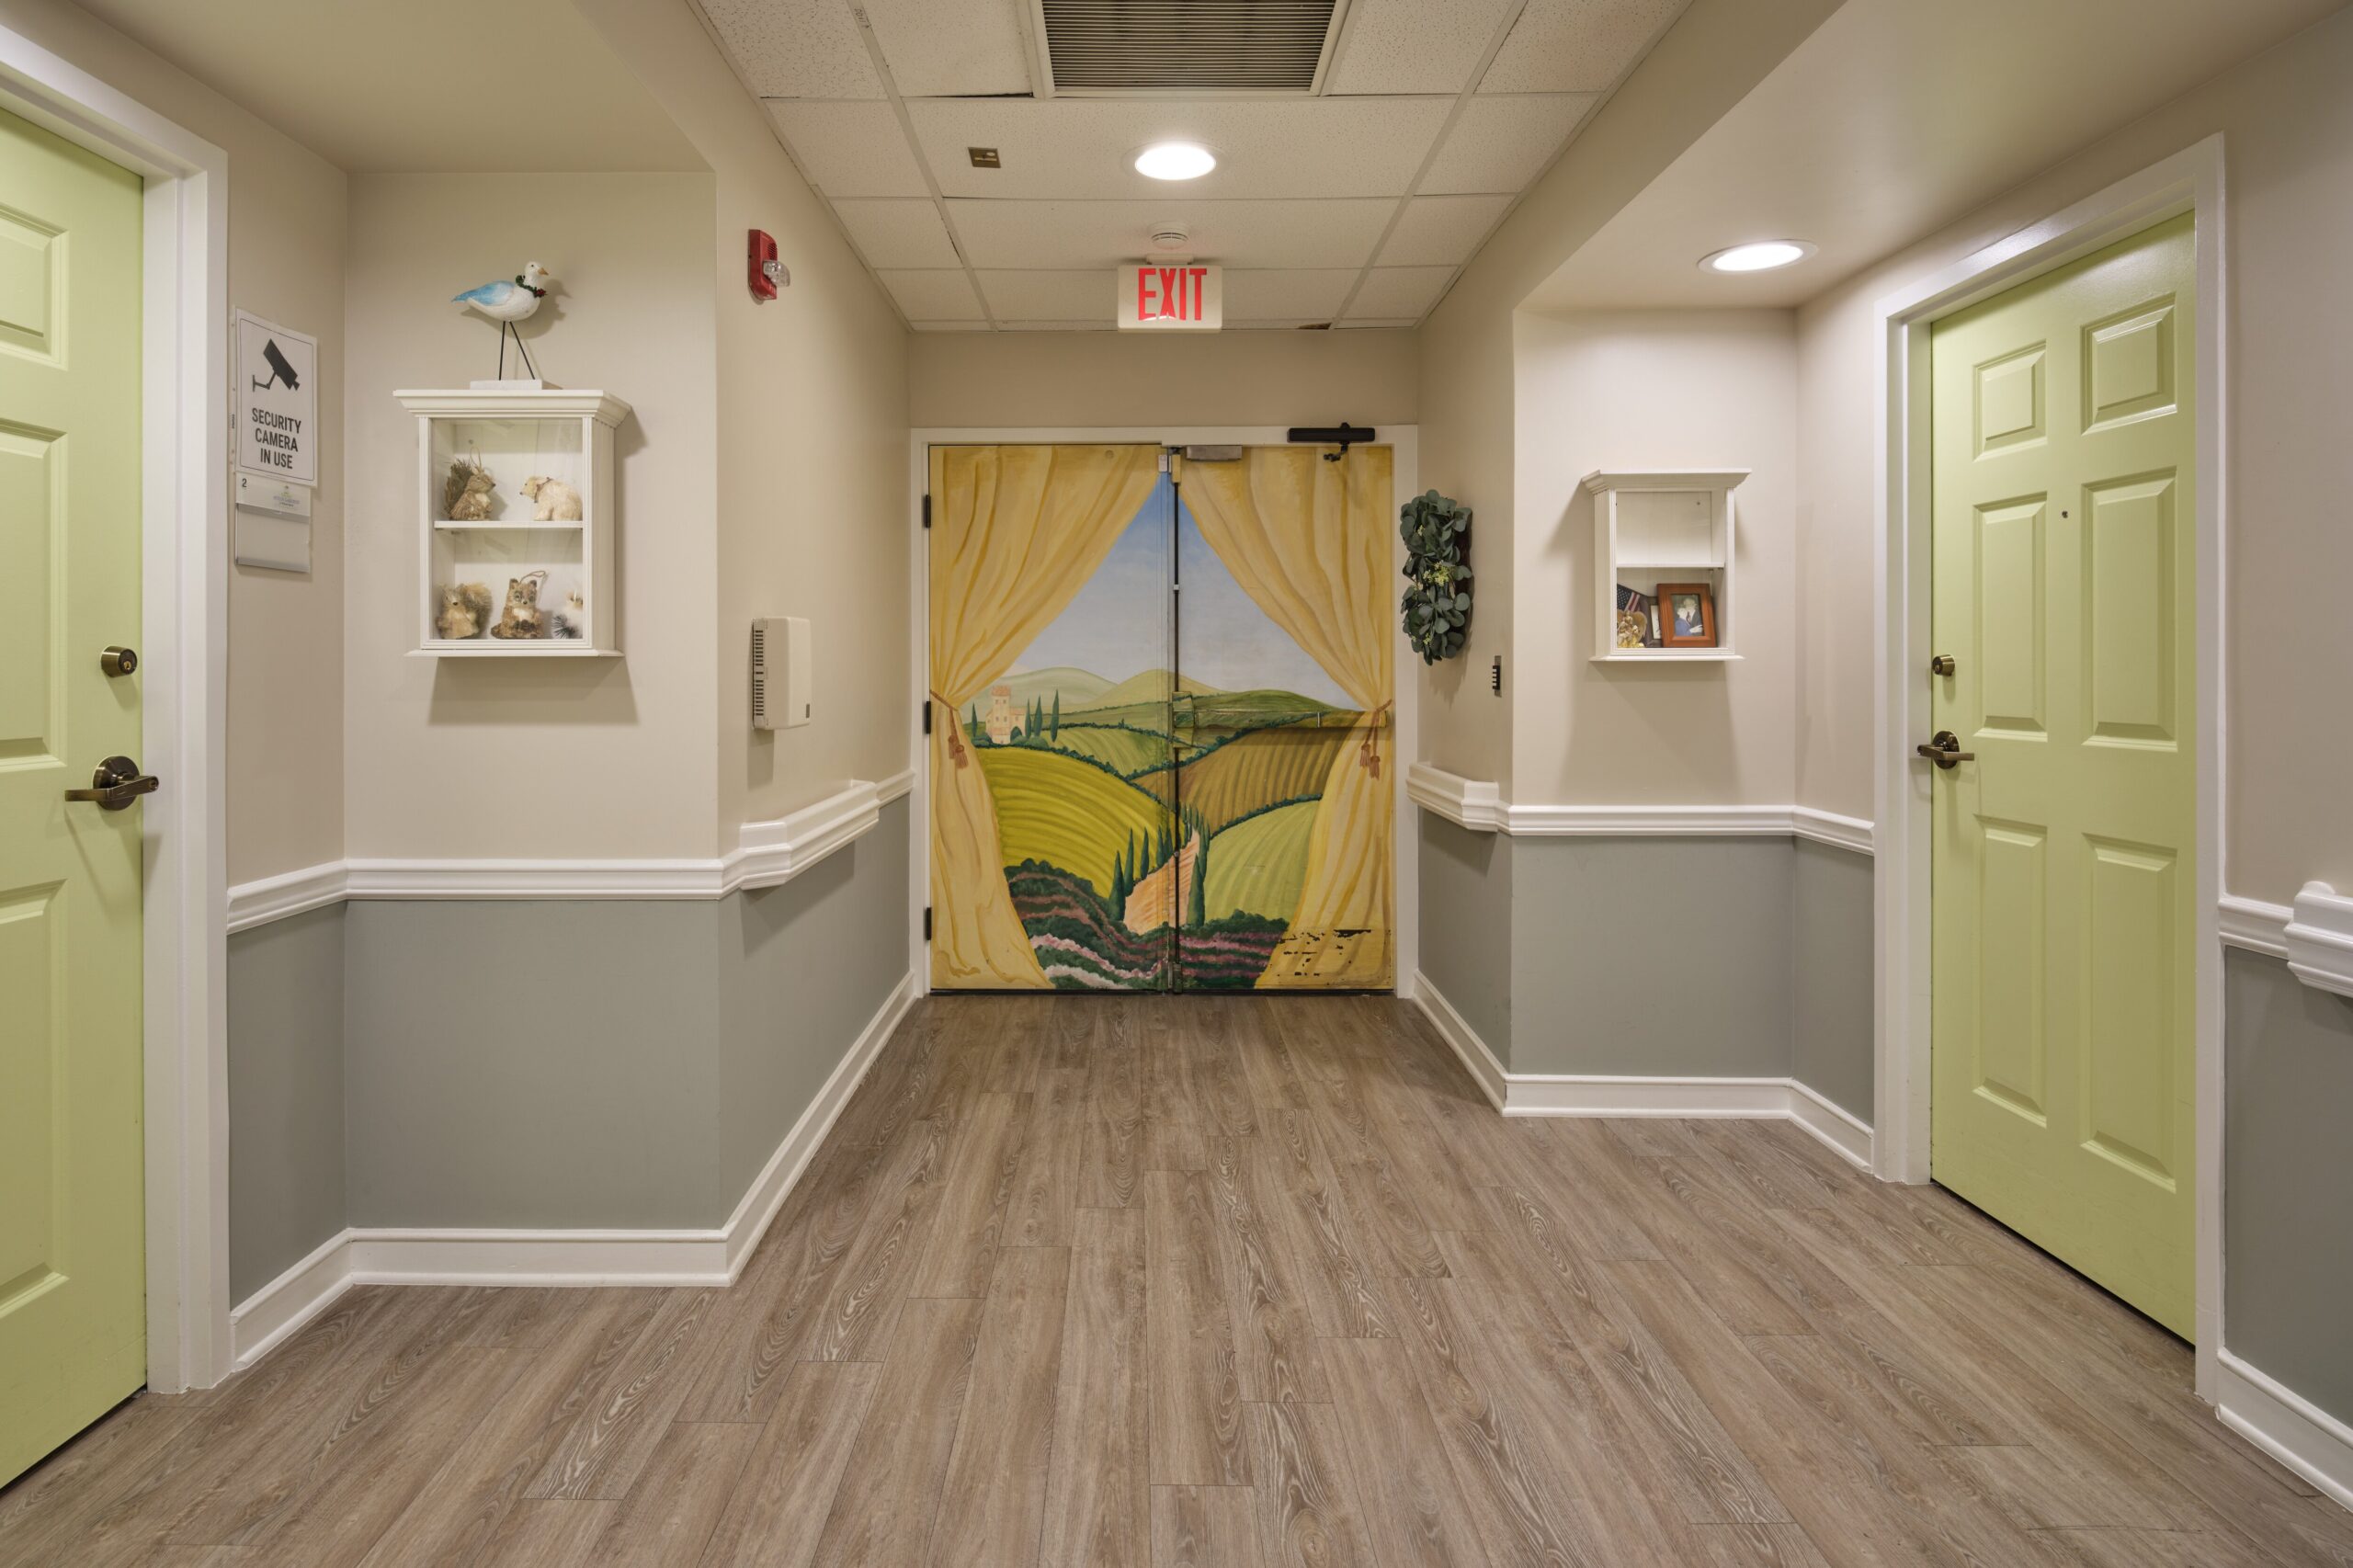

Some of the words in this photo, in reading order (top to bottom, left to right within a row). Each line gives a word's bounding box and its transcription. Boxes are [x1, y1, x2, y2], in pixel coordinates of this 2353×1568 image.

[1138, 267, 1208, 321] EXIT
[251, 407, 301, 434] SECURITY
[255, 427, 299, 452] CAMERA
[260, 448, 271, 464] IN
[274, 451, 293, 470] USE
[242, 478, 247, 488] 2
